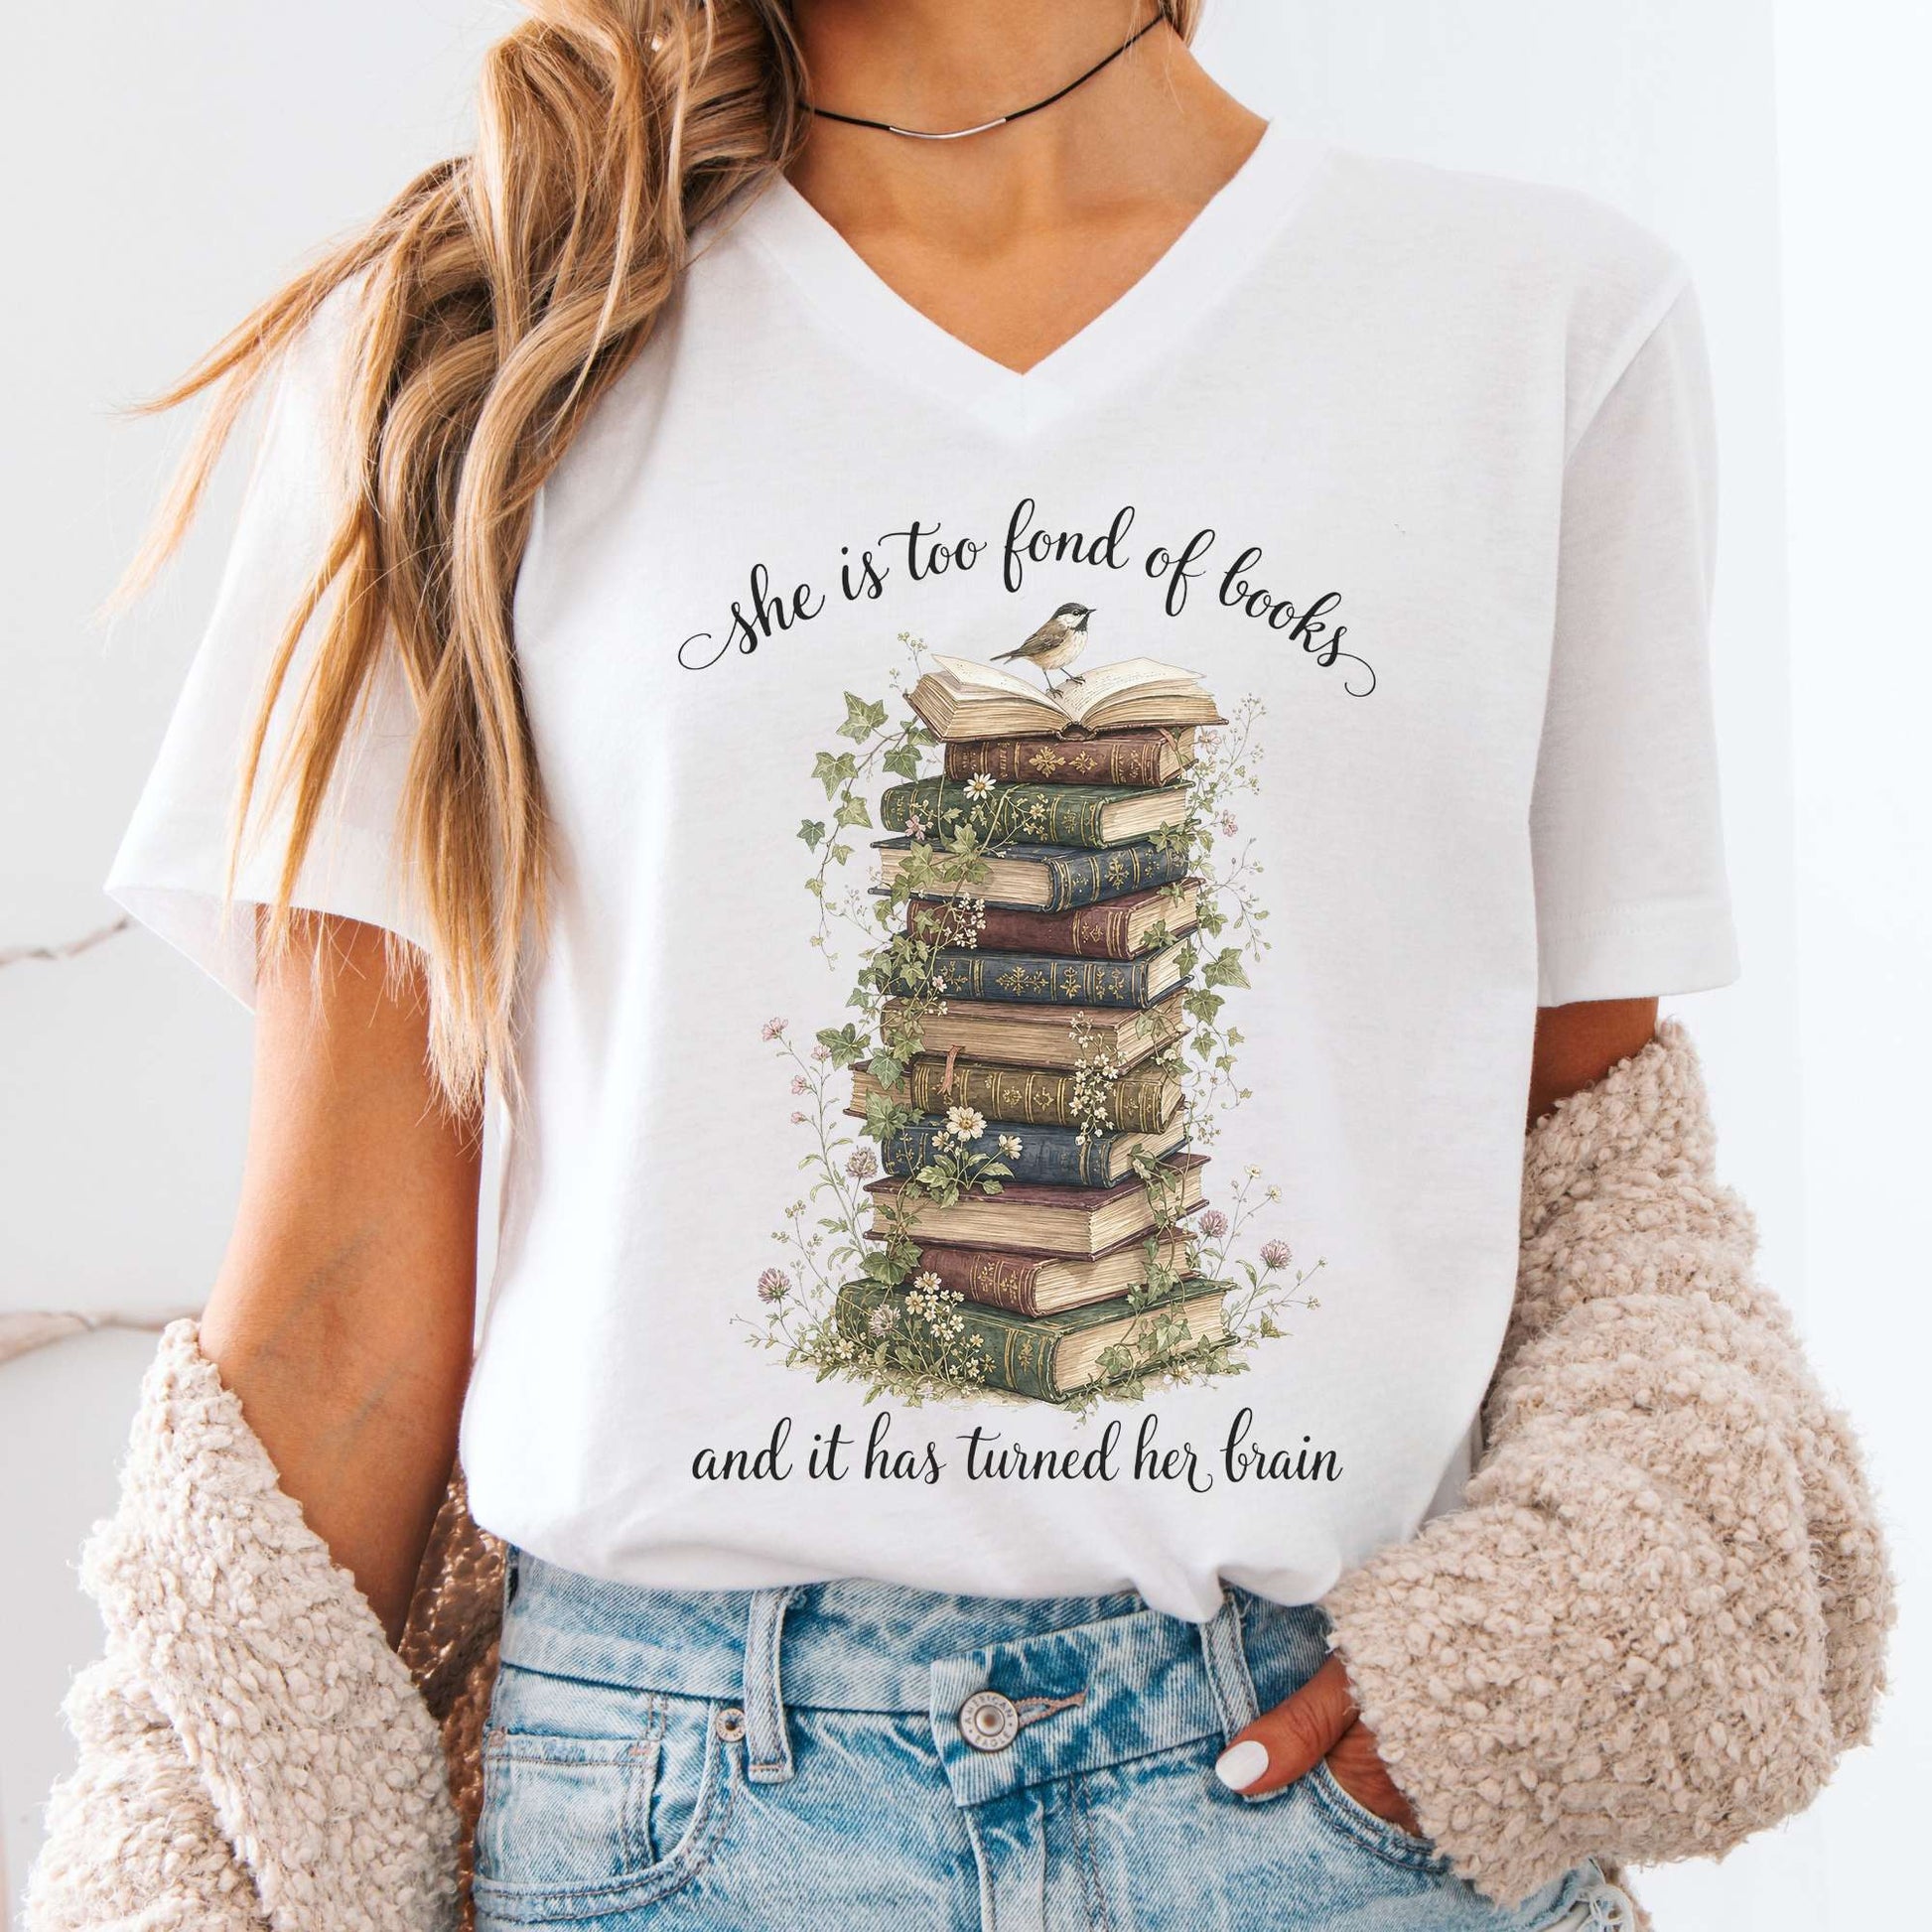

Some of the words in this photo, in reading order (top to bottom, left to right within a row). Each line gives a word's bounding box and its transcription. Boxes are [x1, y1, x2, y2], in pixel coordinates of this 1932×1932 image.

[677, 563, 826, 670] she
[841, 545, 890, 601] is
[877, 520, 988, 581] too
[1003, 497, 1136, 594] fond
[1145, 528, 1216, 618] of
[1218, 546, 1377, 698] books
[692, 1416, 793, 1481] and
[808, 1424, 854, 1481] it
[864, 1411, 947, 1485] has
[956, 1420, 1122, 1482] turned
[1134, 1413, 1213, 1493] her
[1219, 1407, 1343, 1483] brain
[965, 1695, 1014, 1725] AMERICAN
